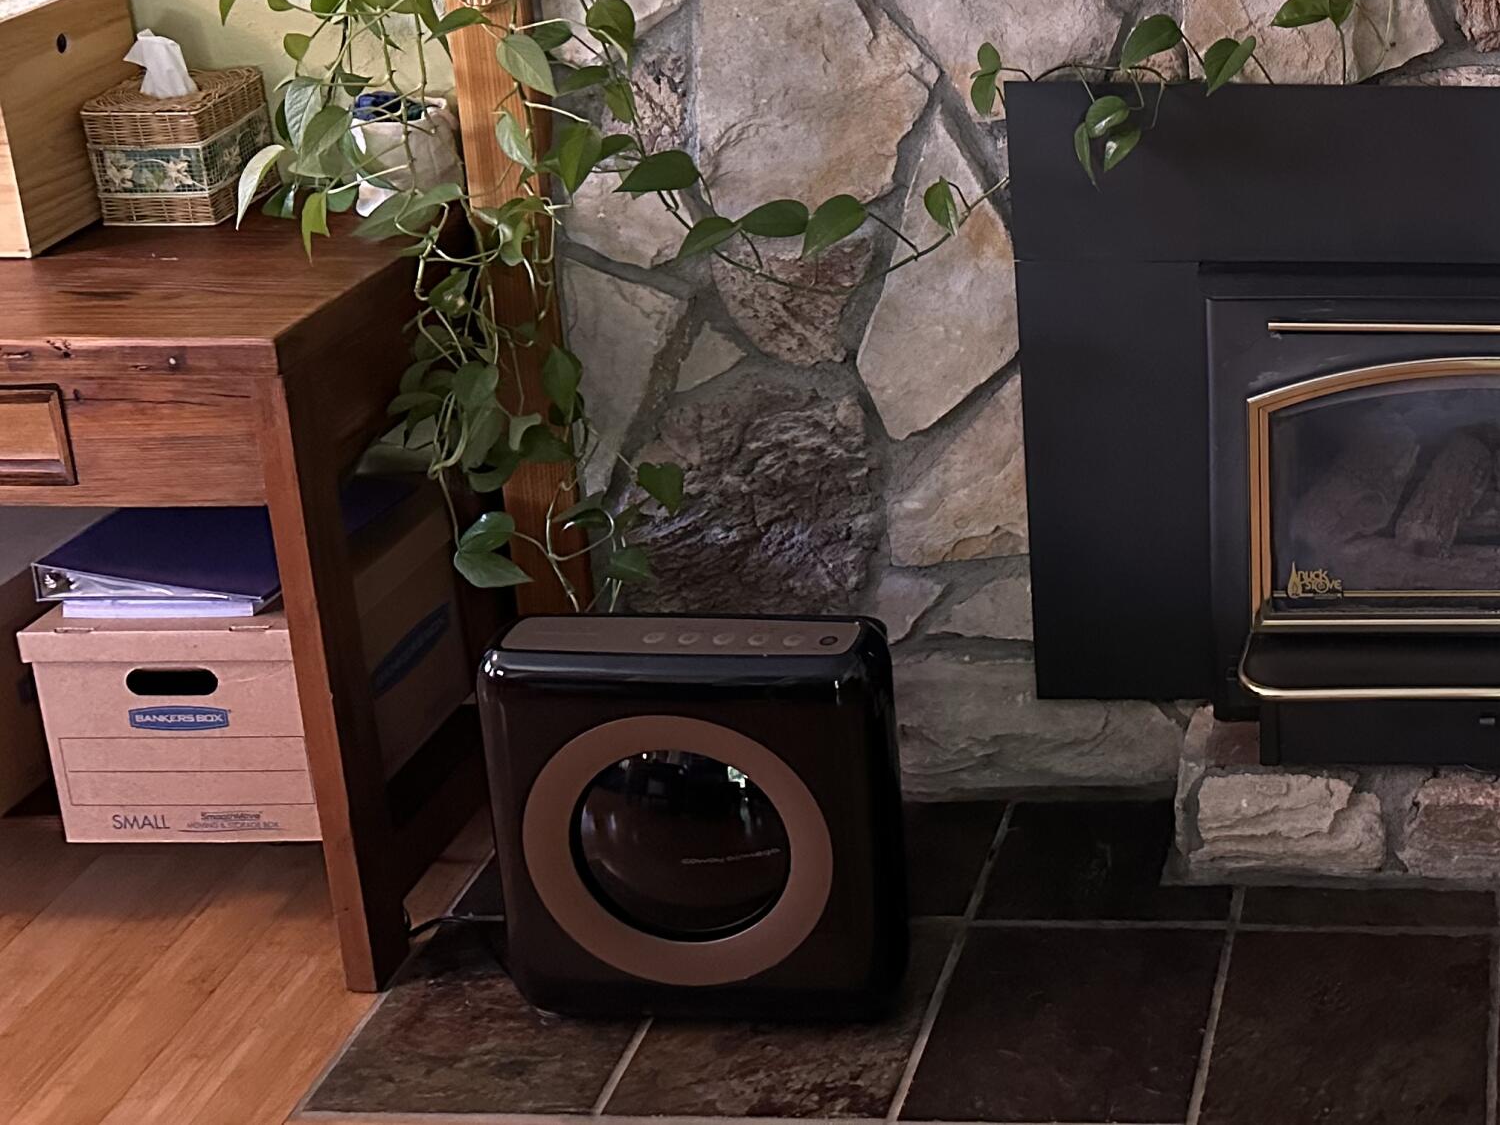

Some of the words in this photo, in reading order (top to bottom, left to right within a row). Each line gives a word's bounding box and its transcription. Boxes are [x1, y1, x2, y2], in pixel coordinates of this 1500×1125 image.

[134, 714, 195, 723] BANKERS
[196, 714, 224, 723] BOX
[112, 814, 170, 830] SMALL
